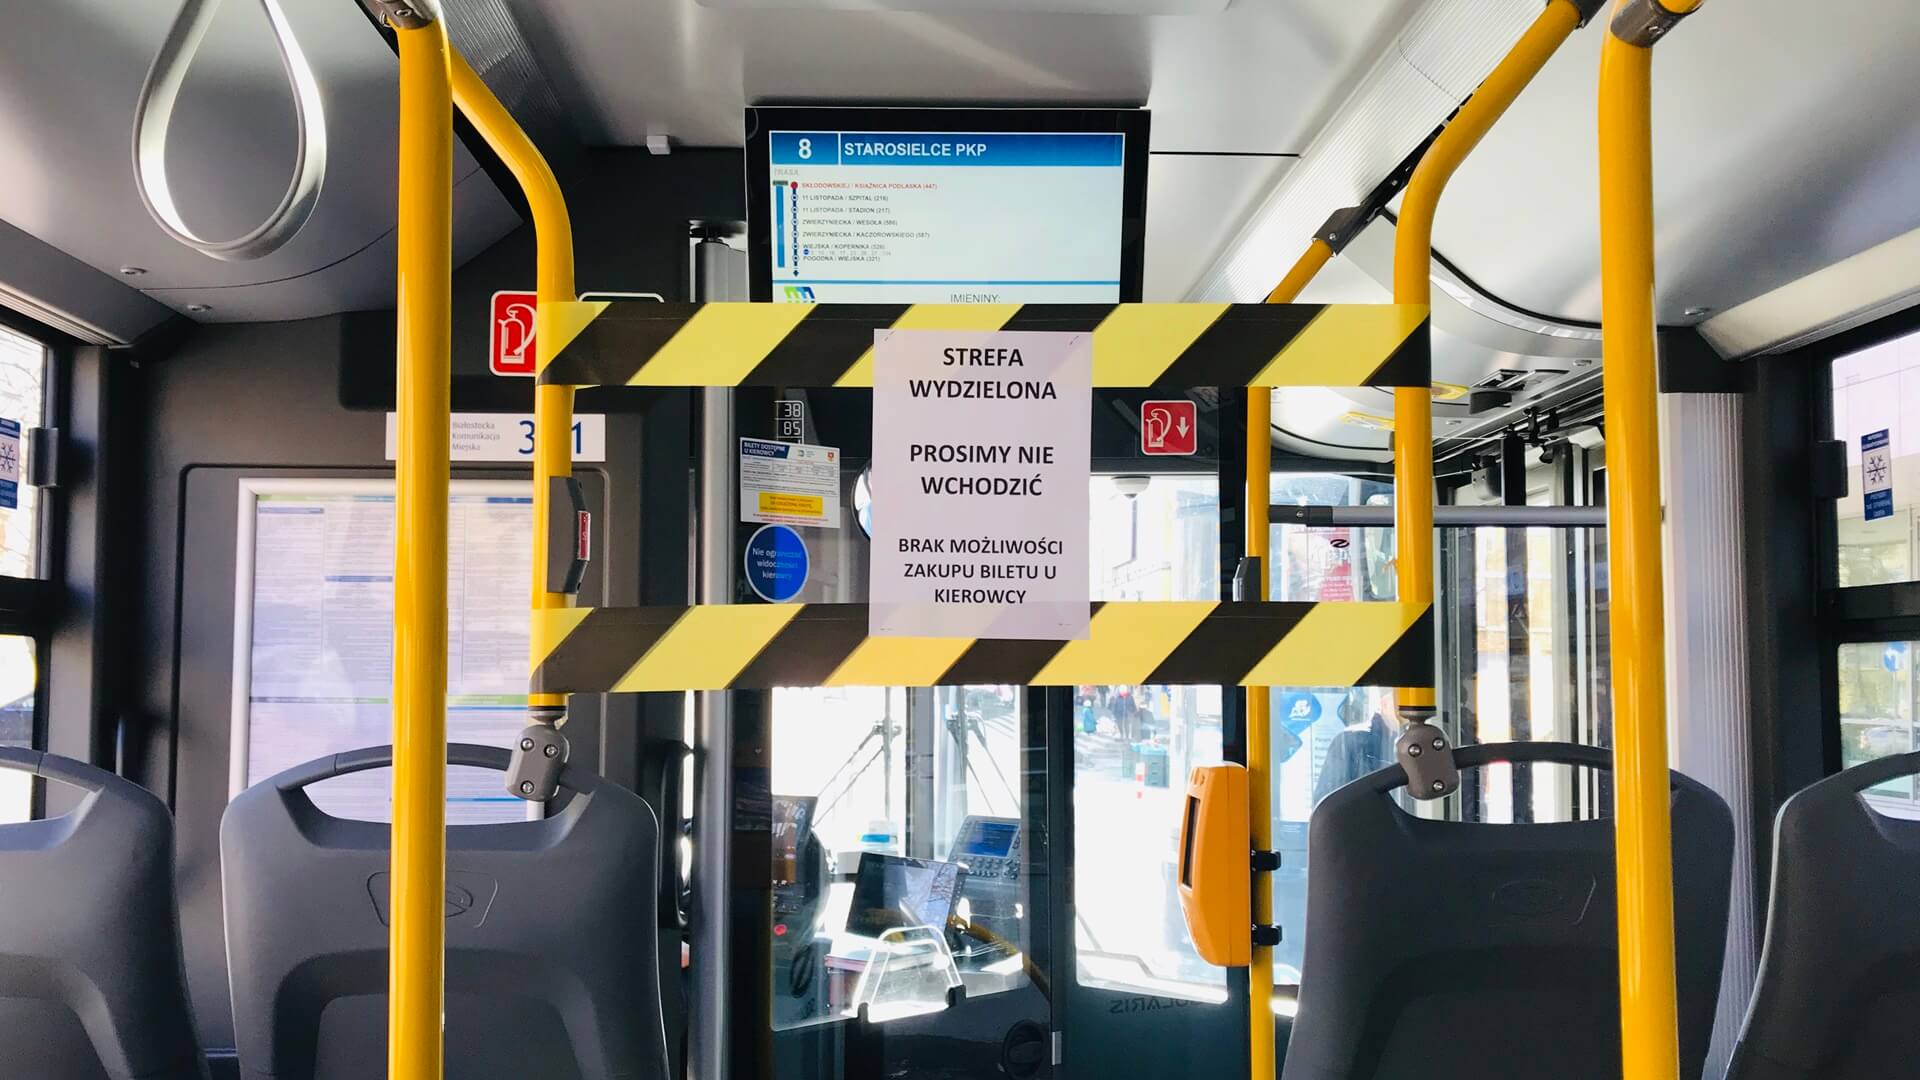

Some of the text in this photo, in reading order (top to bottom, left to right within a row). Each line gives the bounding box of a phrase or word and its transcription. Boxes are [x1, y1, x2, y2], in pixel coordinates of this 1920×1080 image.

[798, 138, 987, 159] 8 STAROSIELCE PKP
[950, 293, 1000, 303] IMIENINY:
[943, 347, 1024, 367] STREFA
[909, 380, 1057, 400] WYDZIELONA
[784, 404, 801, 417] 38
[452, 431, 501, 441] Komunikacja
[784, 421, 801, 436] 85
[518, 420, 582, 455] 31
[452, 442, 481, 452] Miejska
[910, 444, 1054, 464] PROSIMY NIE
[921, 473, 1043, 497] WCHODZIĆ
[752, 547, 765, 556] Nie
[898, 536, 1063, 555] BRAK MOŻLIWOŚCI
[904, 563, 1057, 579] ZAKUPU BILETU U
[934, 588, 1027, 604] KIEROWCY
